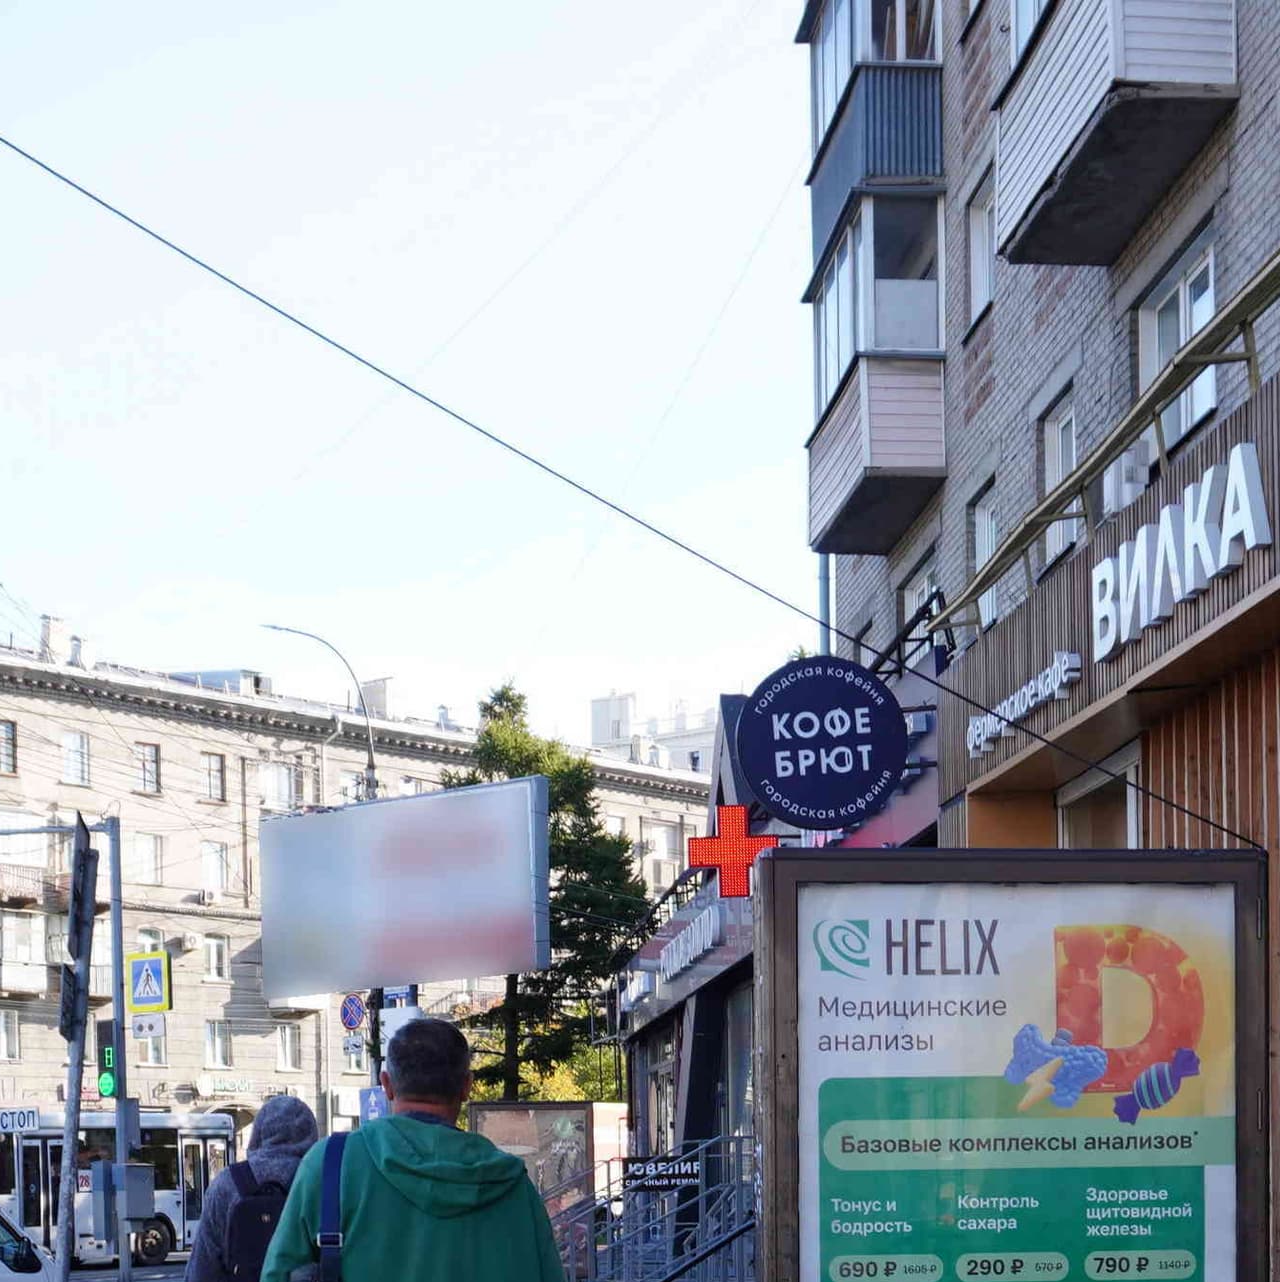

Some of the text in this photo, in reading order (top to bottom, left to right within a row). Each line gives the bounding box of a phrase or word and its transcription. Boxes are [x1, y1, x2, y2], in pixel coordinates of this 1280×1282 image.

[1092, 442, 1270, 662] ВИЛКА
[754, 666, 885, 714] городская кофейня
[967, 651, 1073, 758] фермерское кафе
[772, 707, 871, 741] КОФЕ
[775, 744, 872, 778] БРЮТ
[760, 770, 892, 819] городская кофейня
[885, 919, 1000, 976] HELIX
[818, 996, 1007, 1020] Медицинские
[818, 1032, 934, 1052] анализы
[0, 1110, 36, 1129] СТОП
[840, 1135, 942, 1154] Базовые
[948, 1135, 1077, 1155] комплексы
[957, 1195, 1040, 1212] Контроль
[1086, 1187, 1168, 1205] Здоровье
[831, 1198, 898, 1214] Тонус и
[1086, 1203, 1193, 1221] щитовидной
[831, 1218, 912, 1237] бодрость
[957, 1217, 1018, 1233] сахара
[1086, 1222, 1152, 1237] железы
[840, 1261, 878, 1278] 690
[967, 1259, 1005, 1276] 290
[1093, 1257, 1130, 1273] 790
